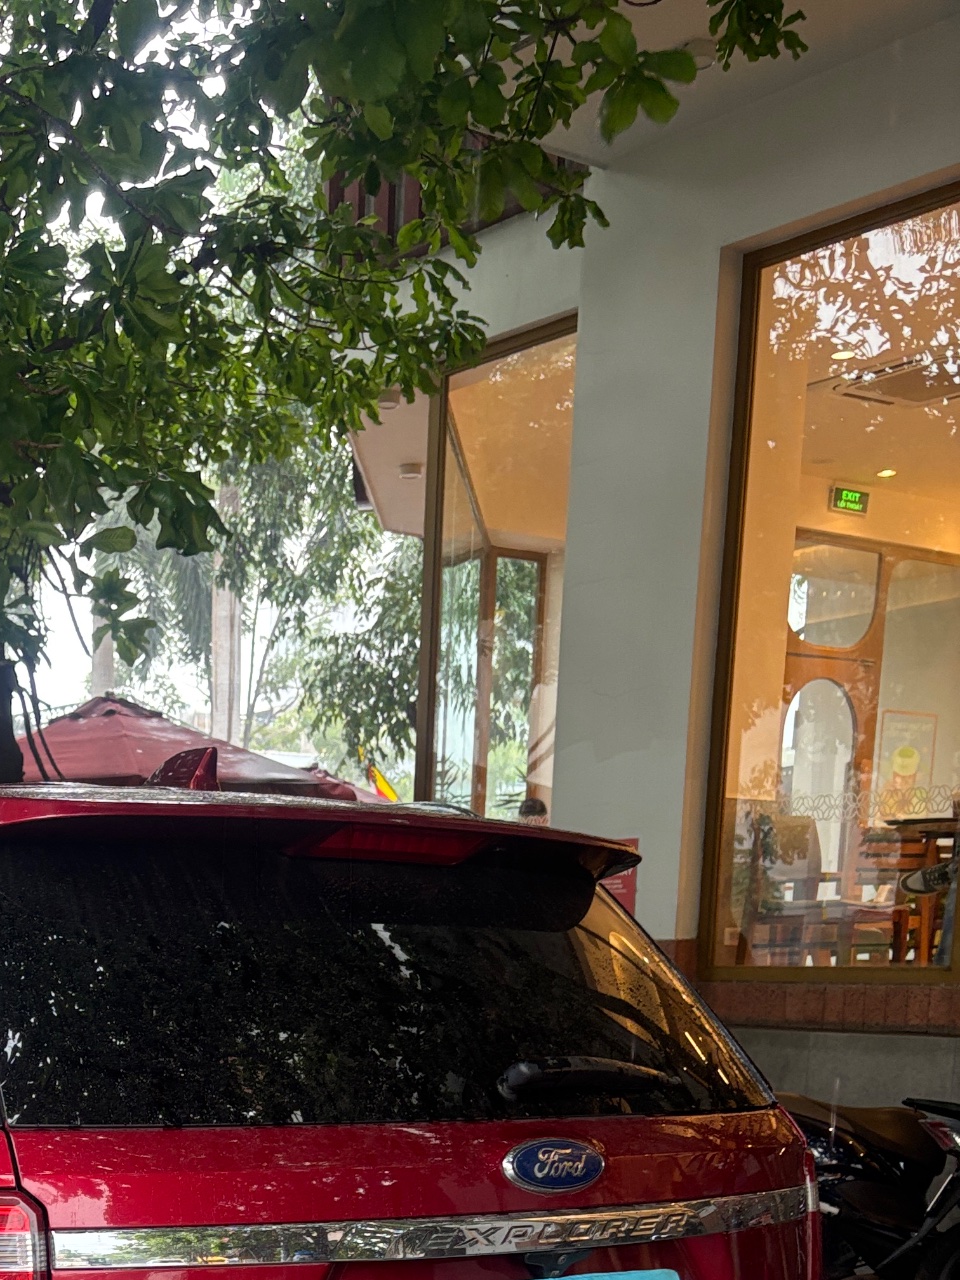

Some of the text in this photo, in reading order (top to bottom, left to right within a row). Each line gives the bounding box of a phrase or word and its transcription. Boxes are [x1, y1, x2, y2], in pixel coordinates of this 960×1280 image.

[842, 490, 860, 502] EXIT
[534, 1147, 587, 1178] Ford
[418, 1212, 689, 1249] EXPLORER
